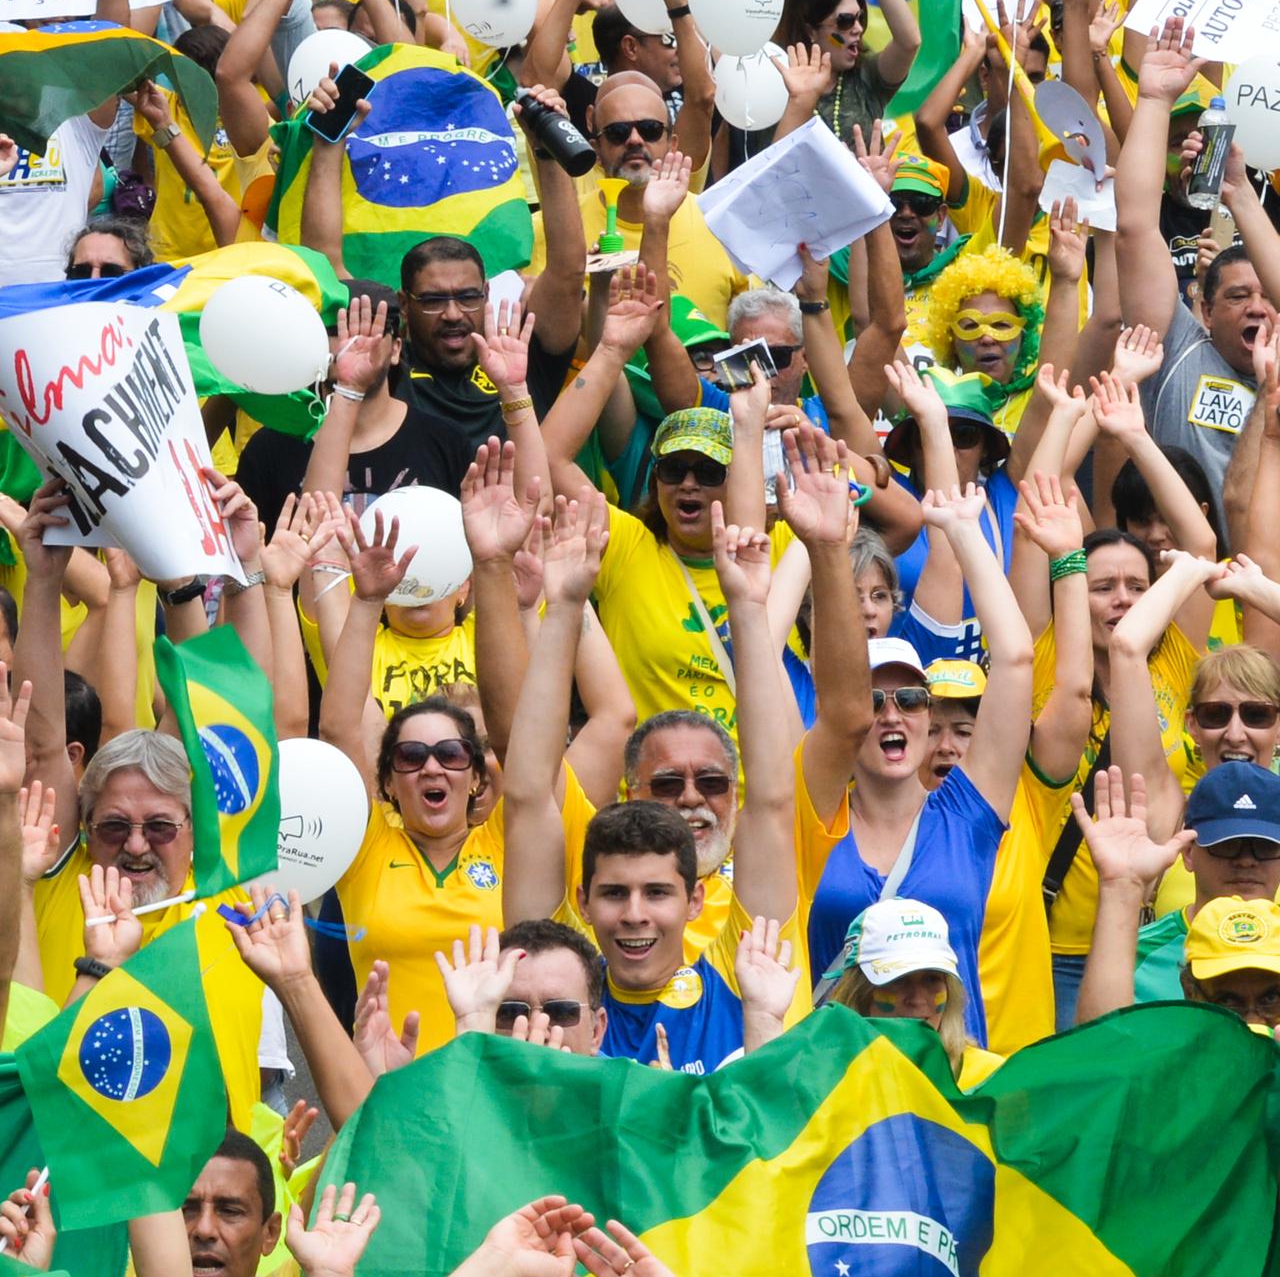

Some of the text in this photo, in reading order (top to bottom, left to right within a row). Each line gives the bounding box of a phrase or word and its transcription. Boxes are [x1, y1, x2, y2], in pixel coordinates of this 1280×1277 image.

[7, 313, 135, 437] ilma:
[1194, 403, 1242, 429] JATO
[1200, 390, 1246, 416] LAVA
[47, 316, 188, 536] ACHMENT
[384, 657, 476, 693] FORA
[690, 654, 719, 674] MEU
[704, 685, 715, 697] O
[276, 843, 325, 863] PraRua.net
[817, 1214, 929, 1242] ORDEM E
